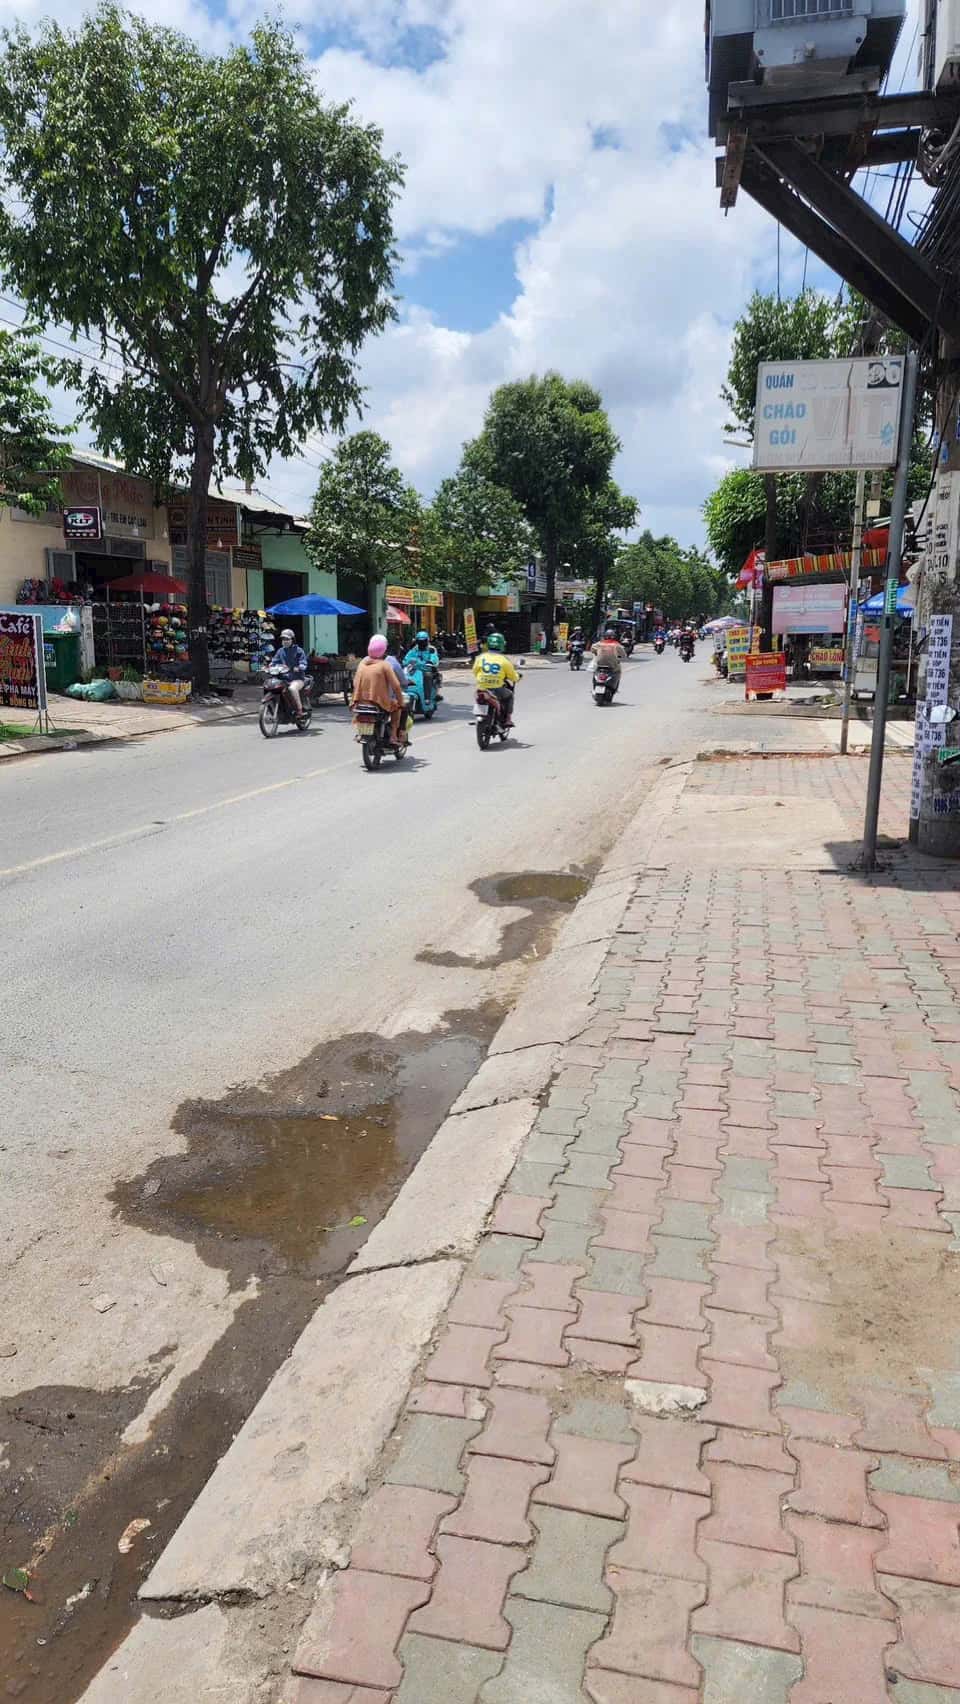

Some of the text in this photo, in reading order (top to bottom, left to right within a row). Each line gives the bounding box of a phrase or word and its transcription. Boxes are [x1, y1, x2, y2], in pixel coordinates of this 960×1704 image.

[766, 371, 795, 390] QUÁN
[763, 400, 806, 420] CHÁO
[0, 616, 30, 634] Café
[482, 658, 501, 674] be
